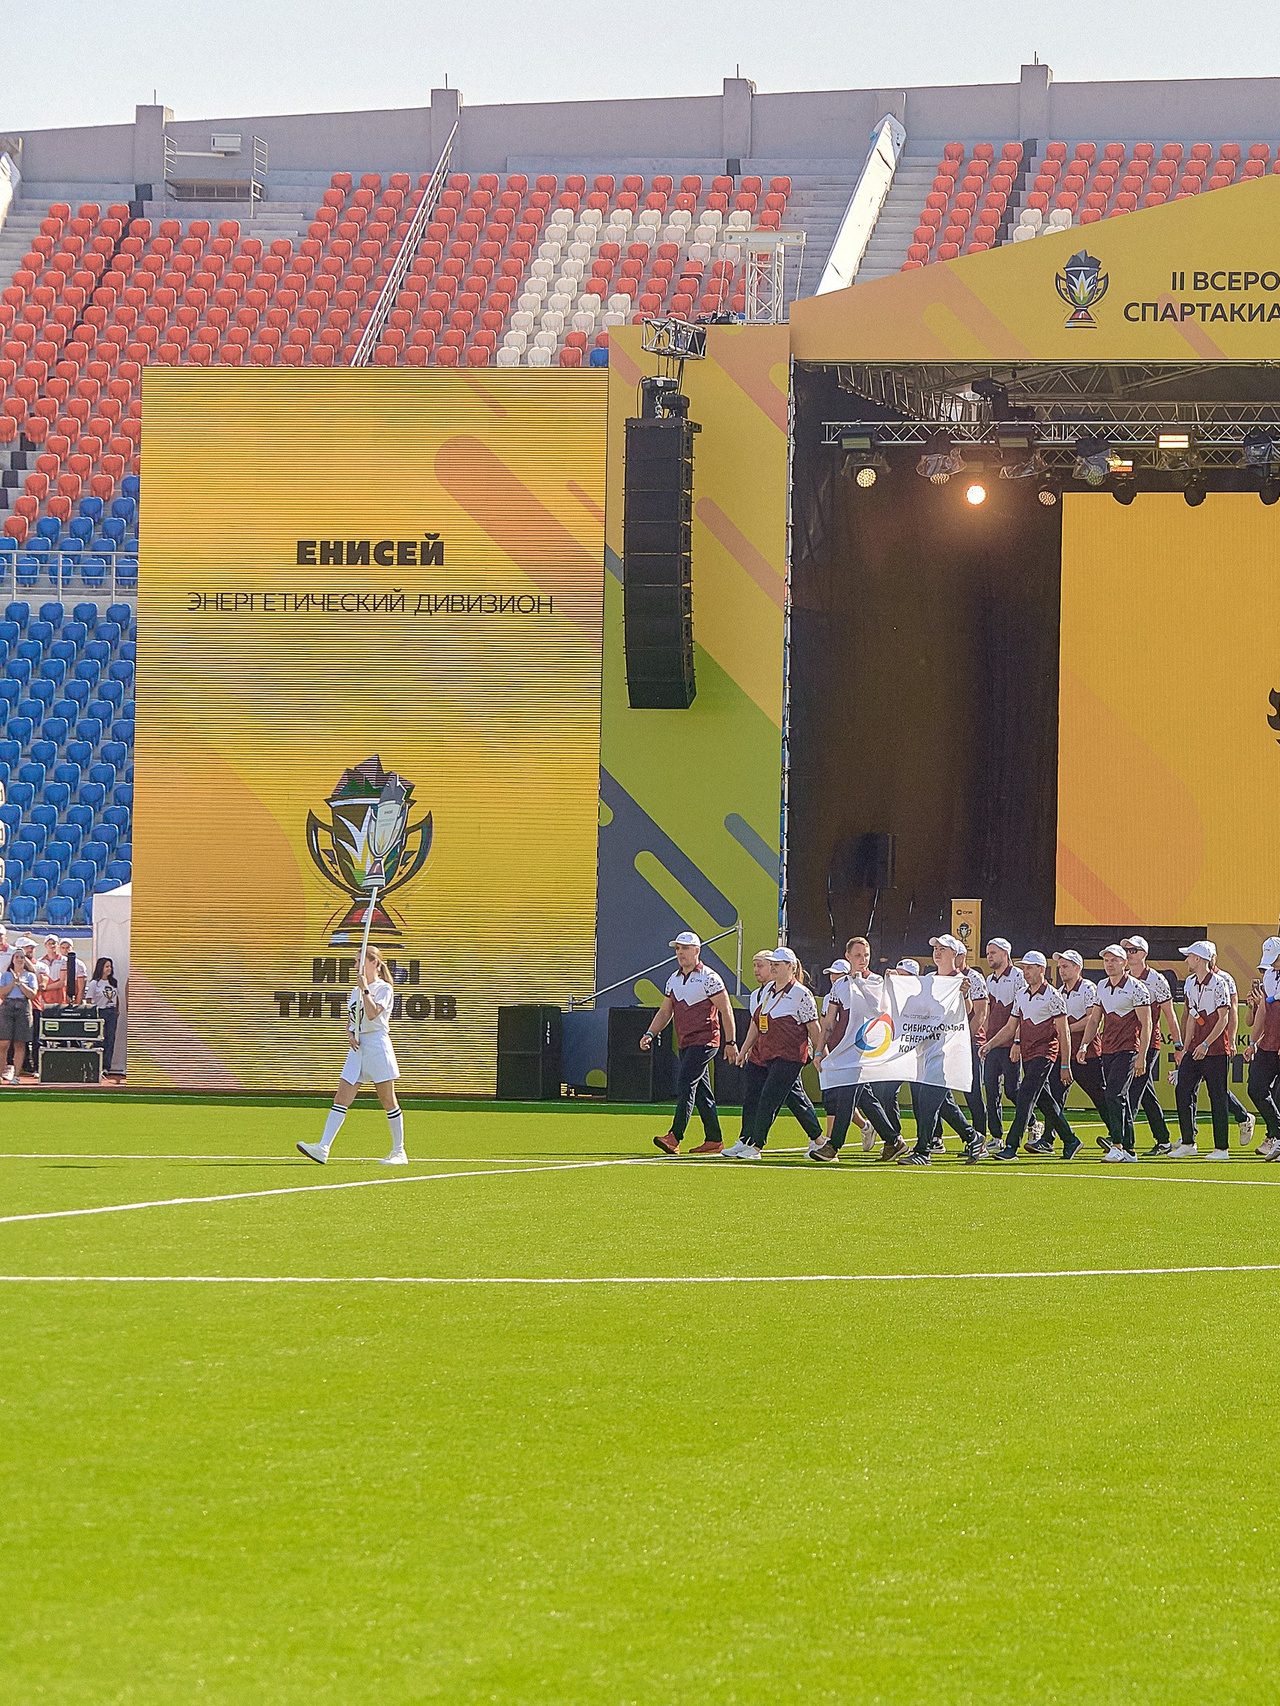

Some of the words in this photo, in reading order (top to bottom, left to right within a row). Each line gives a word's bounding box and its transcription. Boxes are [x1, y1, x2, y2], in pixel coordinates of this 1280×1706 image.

[1171, 270, 1185, 291] II
[296, 532, 444, 566] ЕНИСЕЙ
[187, 588, 406, 613] ЭНЕРГЕТИЧЕСКИЙ
[414, 593, 554, 617] ДИВИЗИОН
[312, 957, 421, 985] ИГЫ
[273, 991, 457, 1021] ТИТОВ
